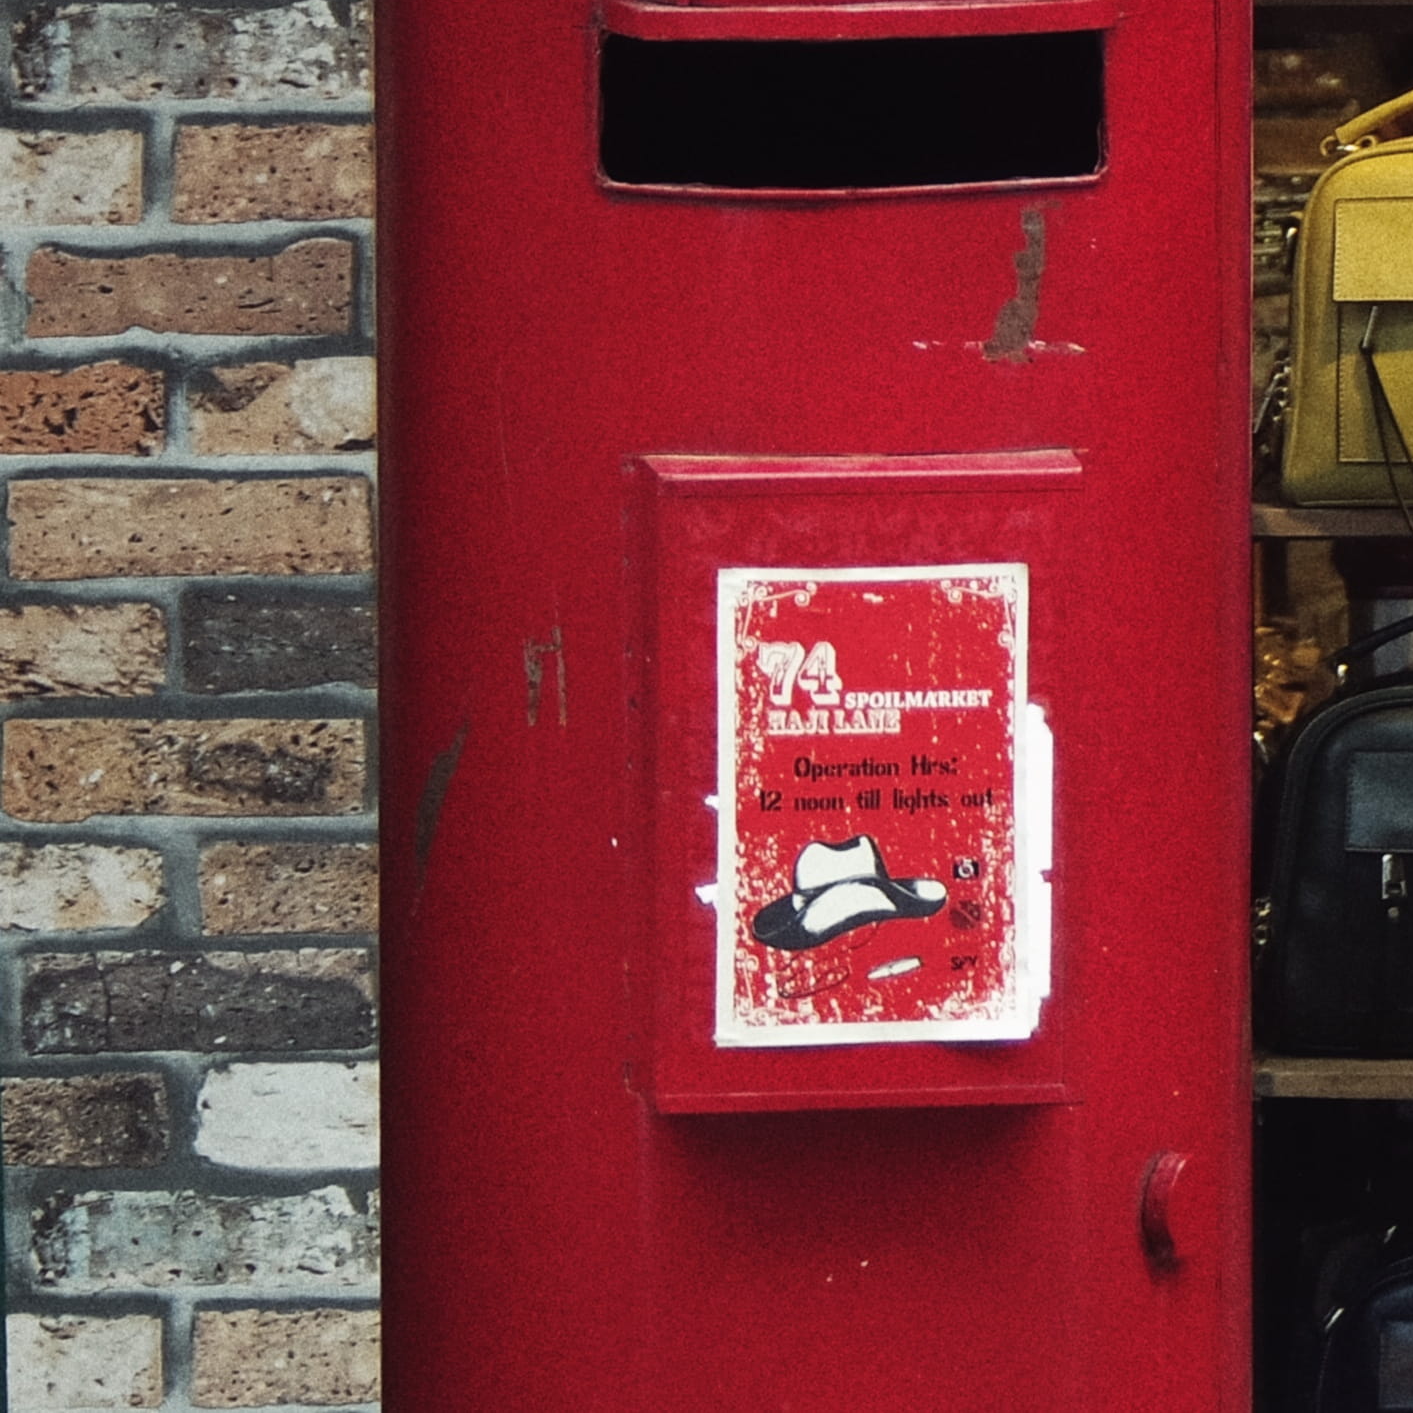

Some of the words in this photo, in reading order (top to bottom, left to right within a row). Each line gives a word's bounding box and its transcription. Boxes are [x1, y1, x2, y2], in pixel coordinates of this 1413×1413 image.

[756, 641, 843, 706] 74
[844, 689, 993, 710] SPOILMARKET
[766, 708, 829, 735] HAJI
[834, 708, 901, 735] LANE
[794, 756, 899, 782] Operation
[911, 754, 958, 776] Hrs:
[759, 790, 782, 812] 12
[794, 794, 844, 811] noon
[856, 788, 881, 810] till
[893, 787, 948, 814] lights
[960, 787, 993, 807] out
